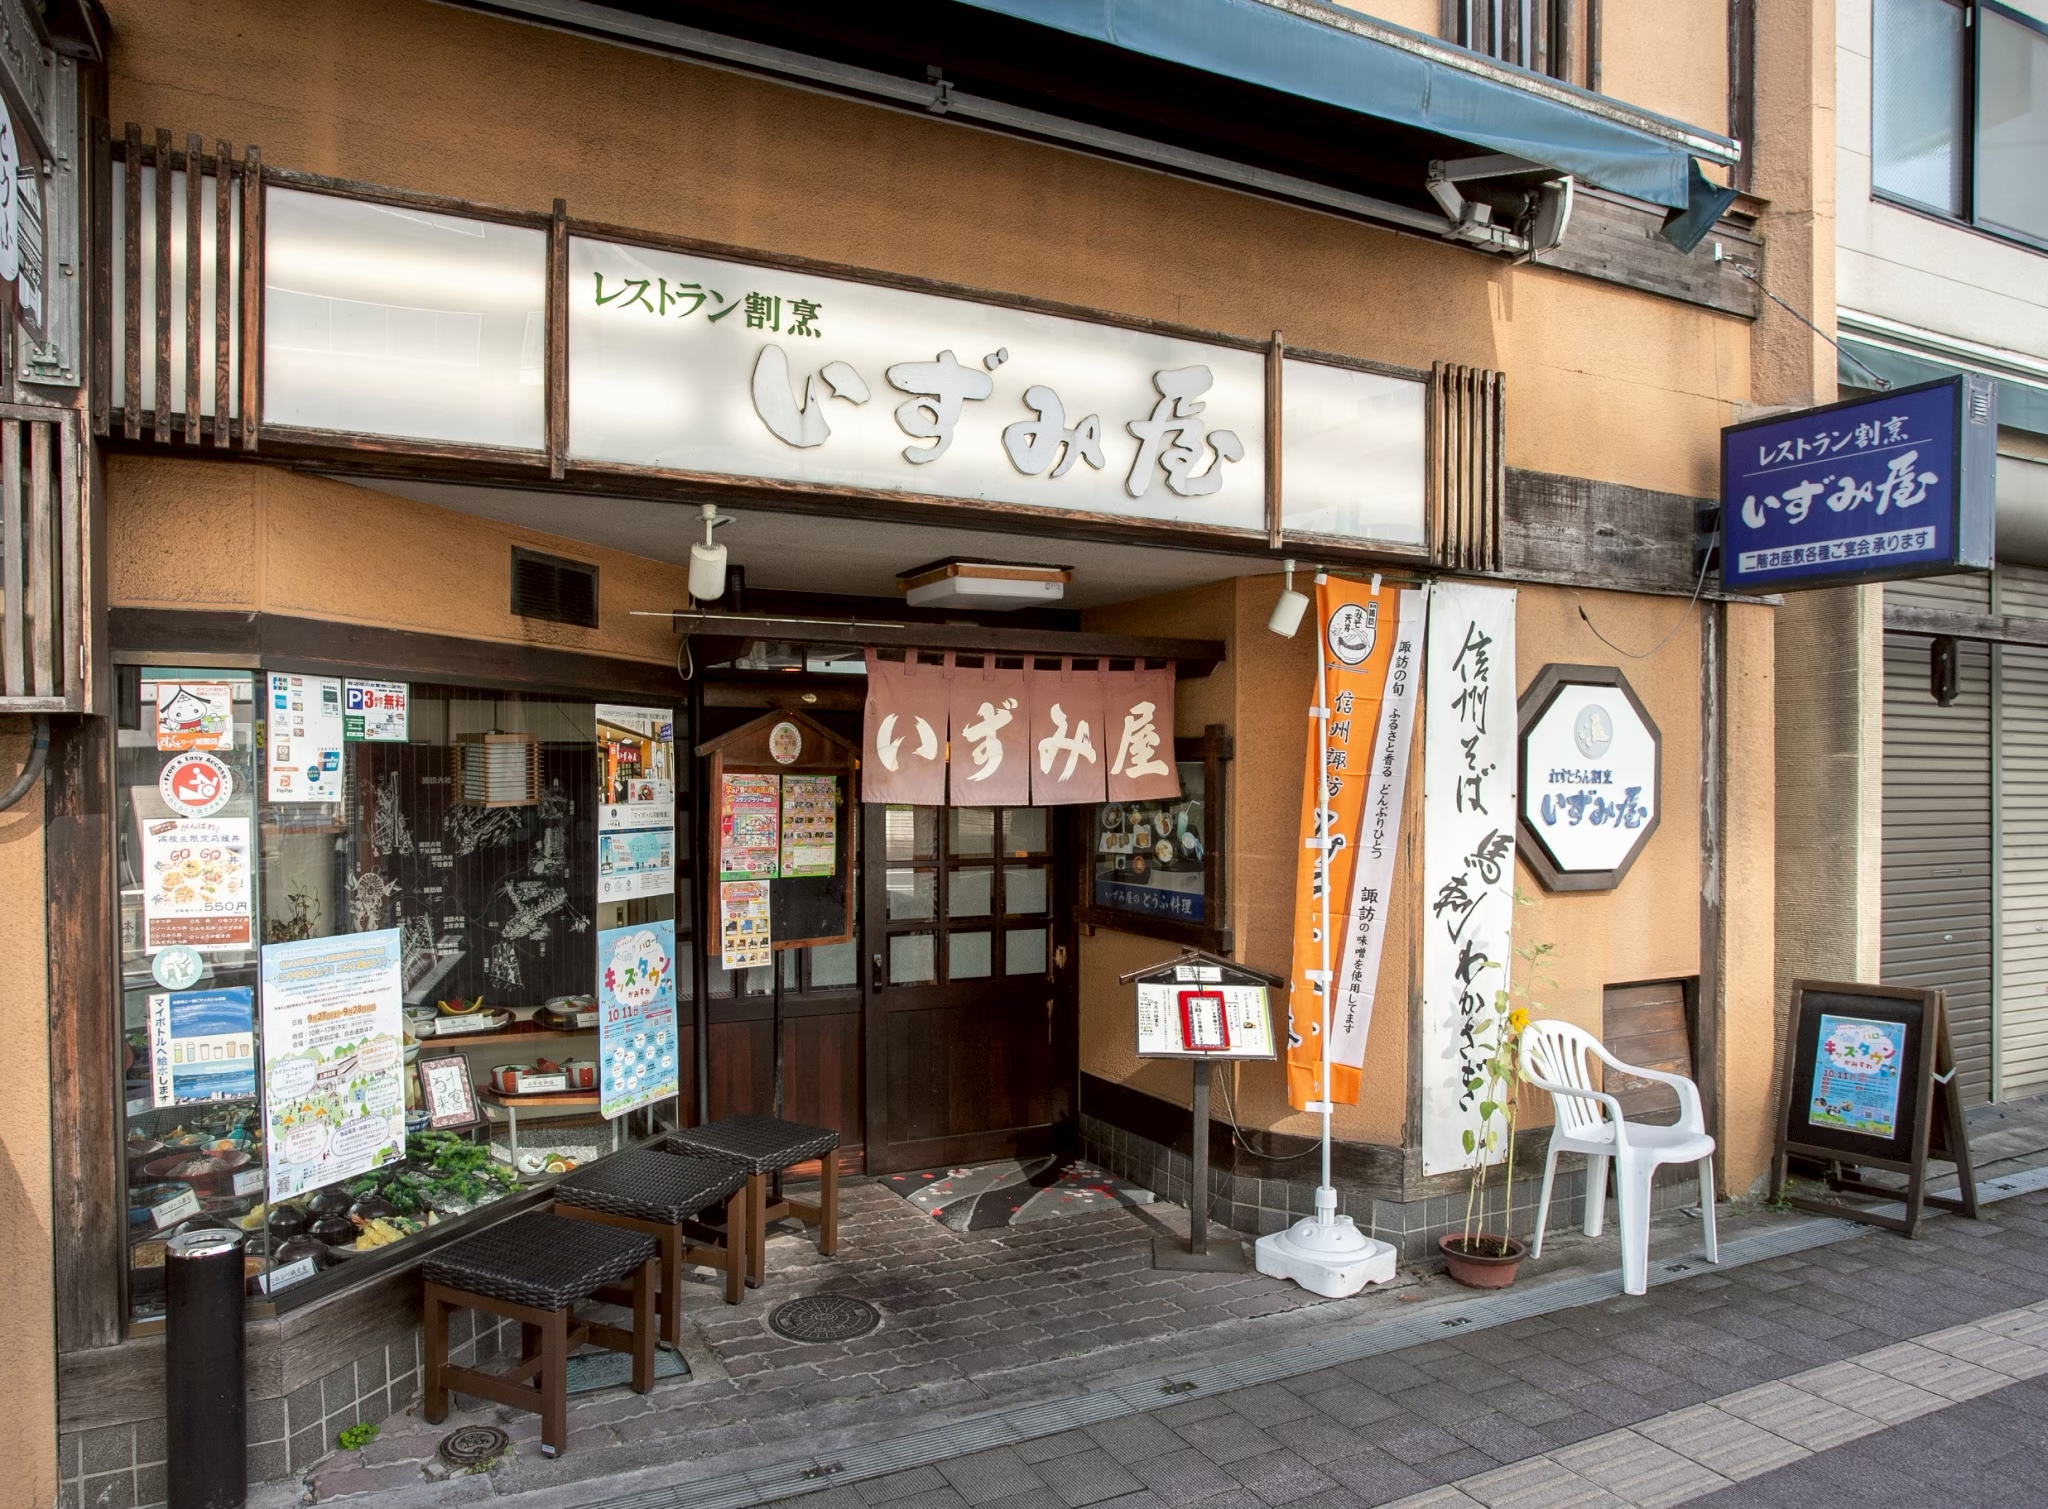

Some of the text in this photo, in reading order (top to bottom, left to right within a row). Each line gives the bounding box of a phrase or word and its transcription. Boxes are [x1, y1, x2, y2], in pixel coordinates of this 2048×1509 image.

[593, 271, 823, 338] レストラン割烹
[751, 343, 1245, 498] いずみ屋
[1759, 416, 1909, 467] レストラン割烹
[1741, 450, 1939, 529] いずみ屋
[1744, 531, 1929, 571] 二階お座敷各種ご宴会承ります
[1392, 640, 1412, 697] 諏訪の旬
[383, 693, 405, 711] 無料
[1451, 620, 1496, 815] 信州そば
[876, 698, 1170, 783] いずみ屋
[1381, 708, 1401, 778] ふるさと香る
[163, 765, 176, 782] Free
[205, 757, 228, 780] Access
[1541, 786, 1648, 829] いずみ屋
[170, 848, 221, 861] GO GO
[204, 901, 247, 912] 550円
[123, 920, 134, 944] 本金
[604, 956, 671, 993] キッズタウン
[1344, 886, 1379, 1034] 諏訪の味噌を使用してます
[627, 987, 650, 999] かみすわ
[607, 1005, 633, 1023] 10.11
[1454, 938, 1488, 1112] わかさぎ
[154, 998, 169, 1105] マイボトルへ給水します
[1824, 1040, 1896, 1066] キッズタウン
[1843, 1059, 1873, 1070] かみすわ
[1823, 1069, 1848, 1080] 10.11
